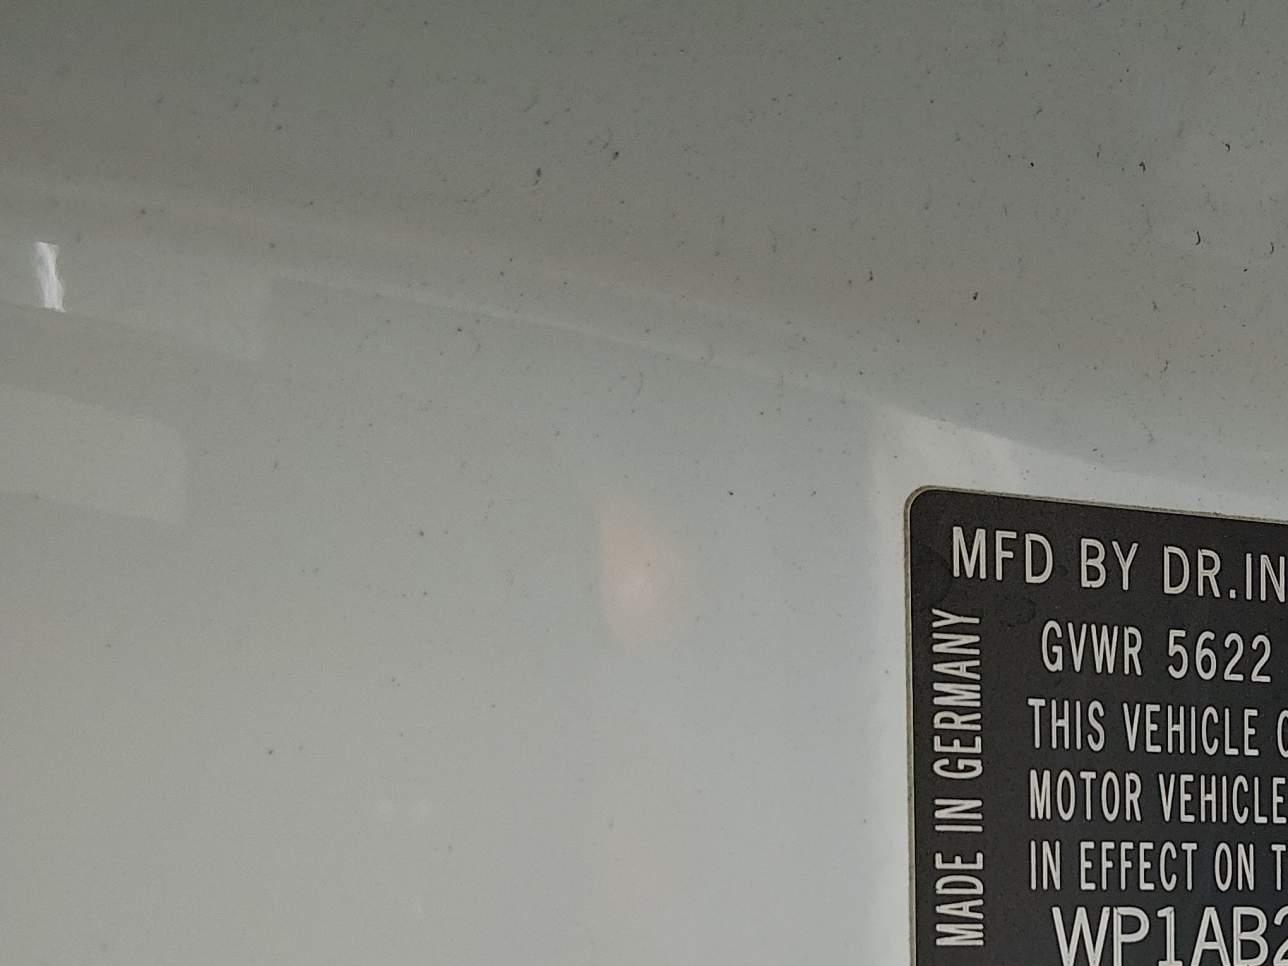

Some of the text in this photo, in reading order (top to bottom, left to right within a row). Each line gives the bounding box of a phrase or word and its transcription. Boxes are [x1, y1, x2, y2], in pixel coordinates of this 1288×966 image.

[952, 526, 1053, 584] MFD
[1081, 538, 1138, 591] BY
[1042, 620, 1271, 683] GVWR 5622
[1028, 698, 1105, 752] THIS
[1122, 703, 1259, 756] VEHICLE
[931, 607, 985, 947] MADE IN GERMANY
[1029, 769, 1142, 822] MOTOR
[1158, 773, 1287, 824] VEHICLE
[1030, 840, 1061, 891] IN
[1079, 841, 1198, 892] EFFECT
[1214, 842, 1255, 892] ON
